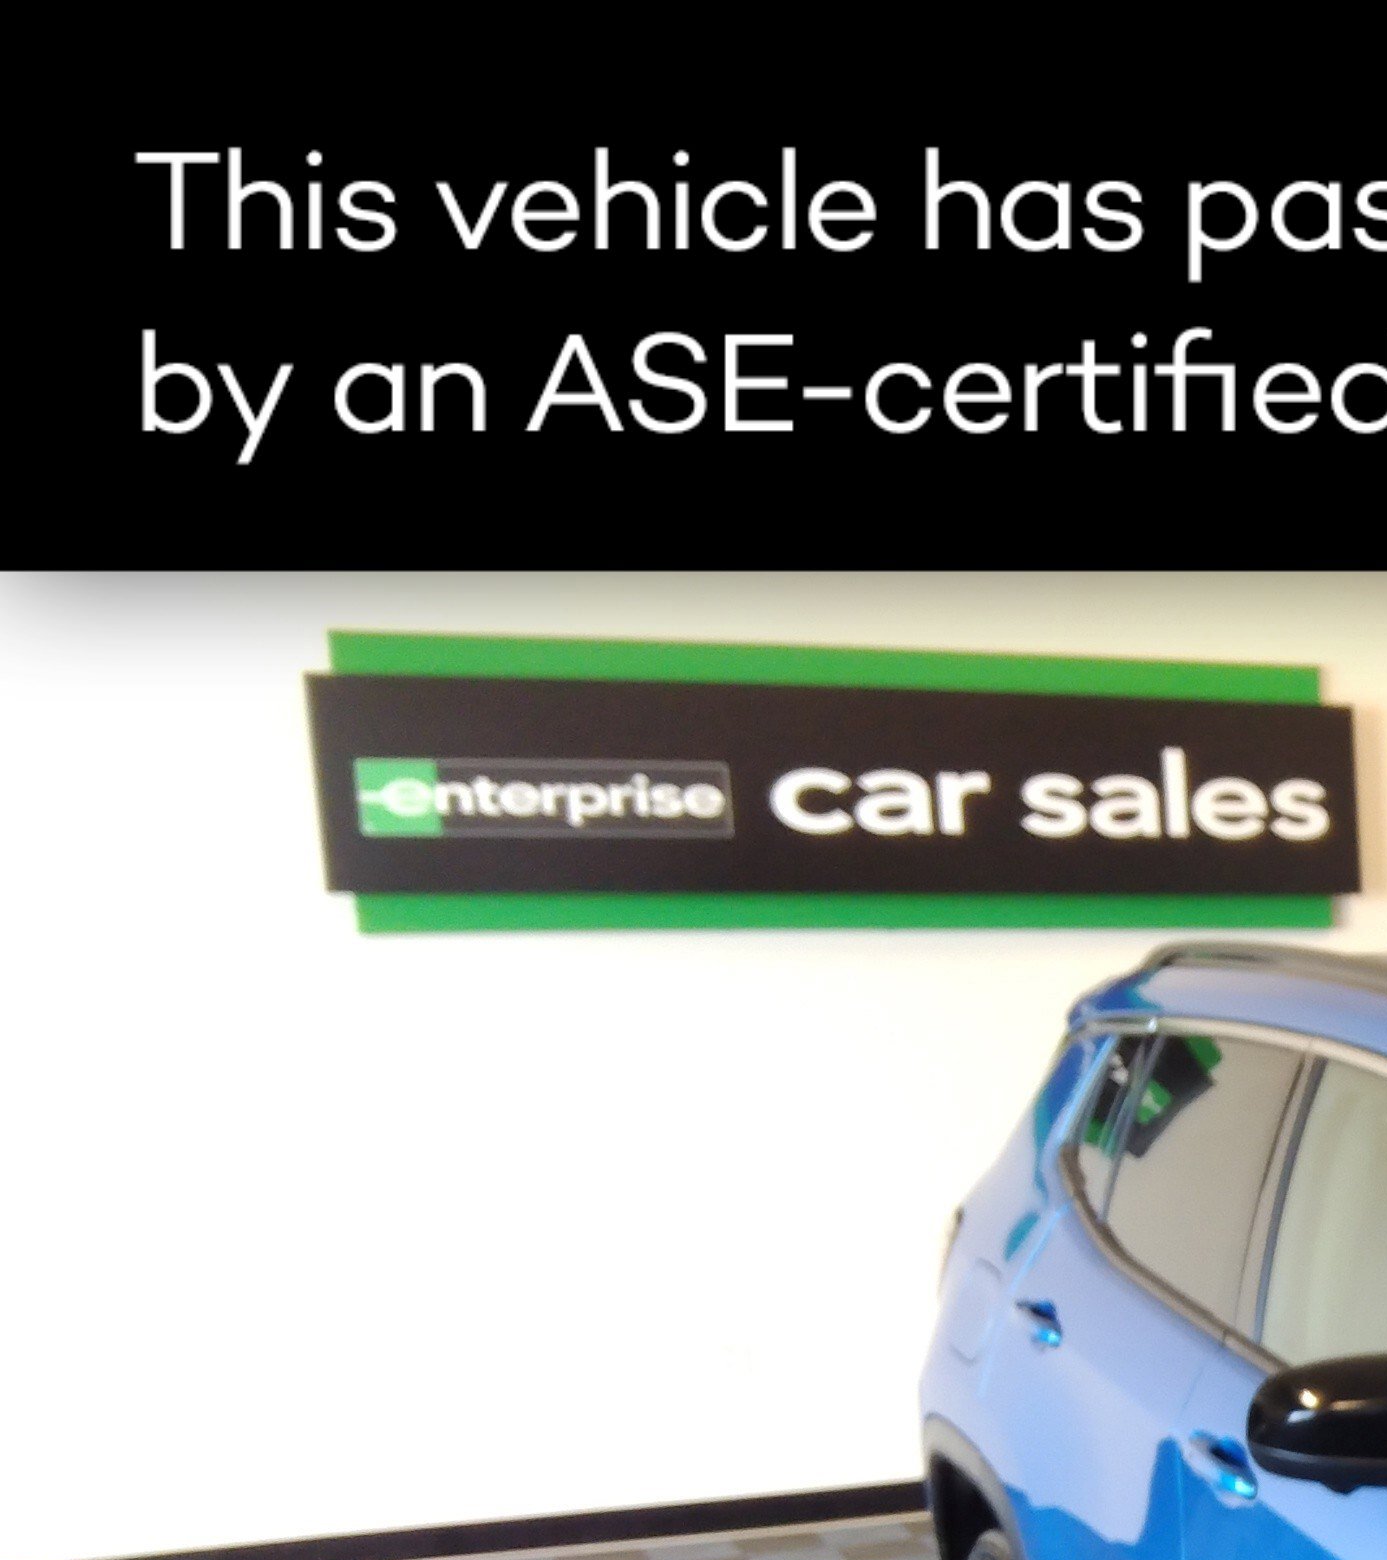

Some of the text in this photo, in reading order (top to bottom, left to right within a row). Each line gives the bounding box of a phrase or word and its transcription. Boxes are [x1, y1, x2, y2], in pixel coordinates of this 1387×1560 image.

[362, 746, 1330, 841] enterprise car sales
